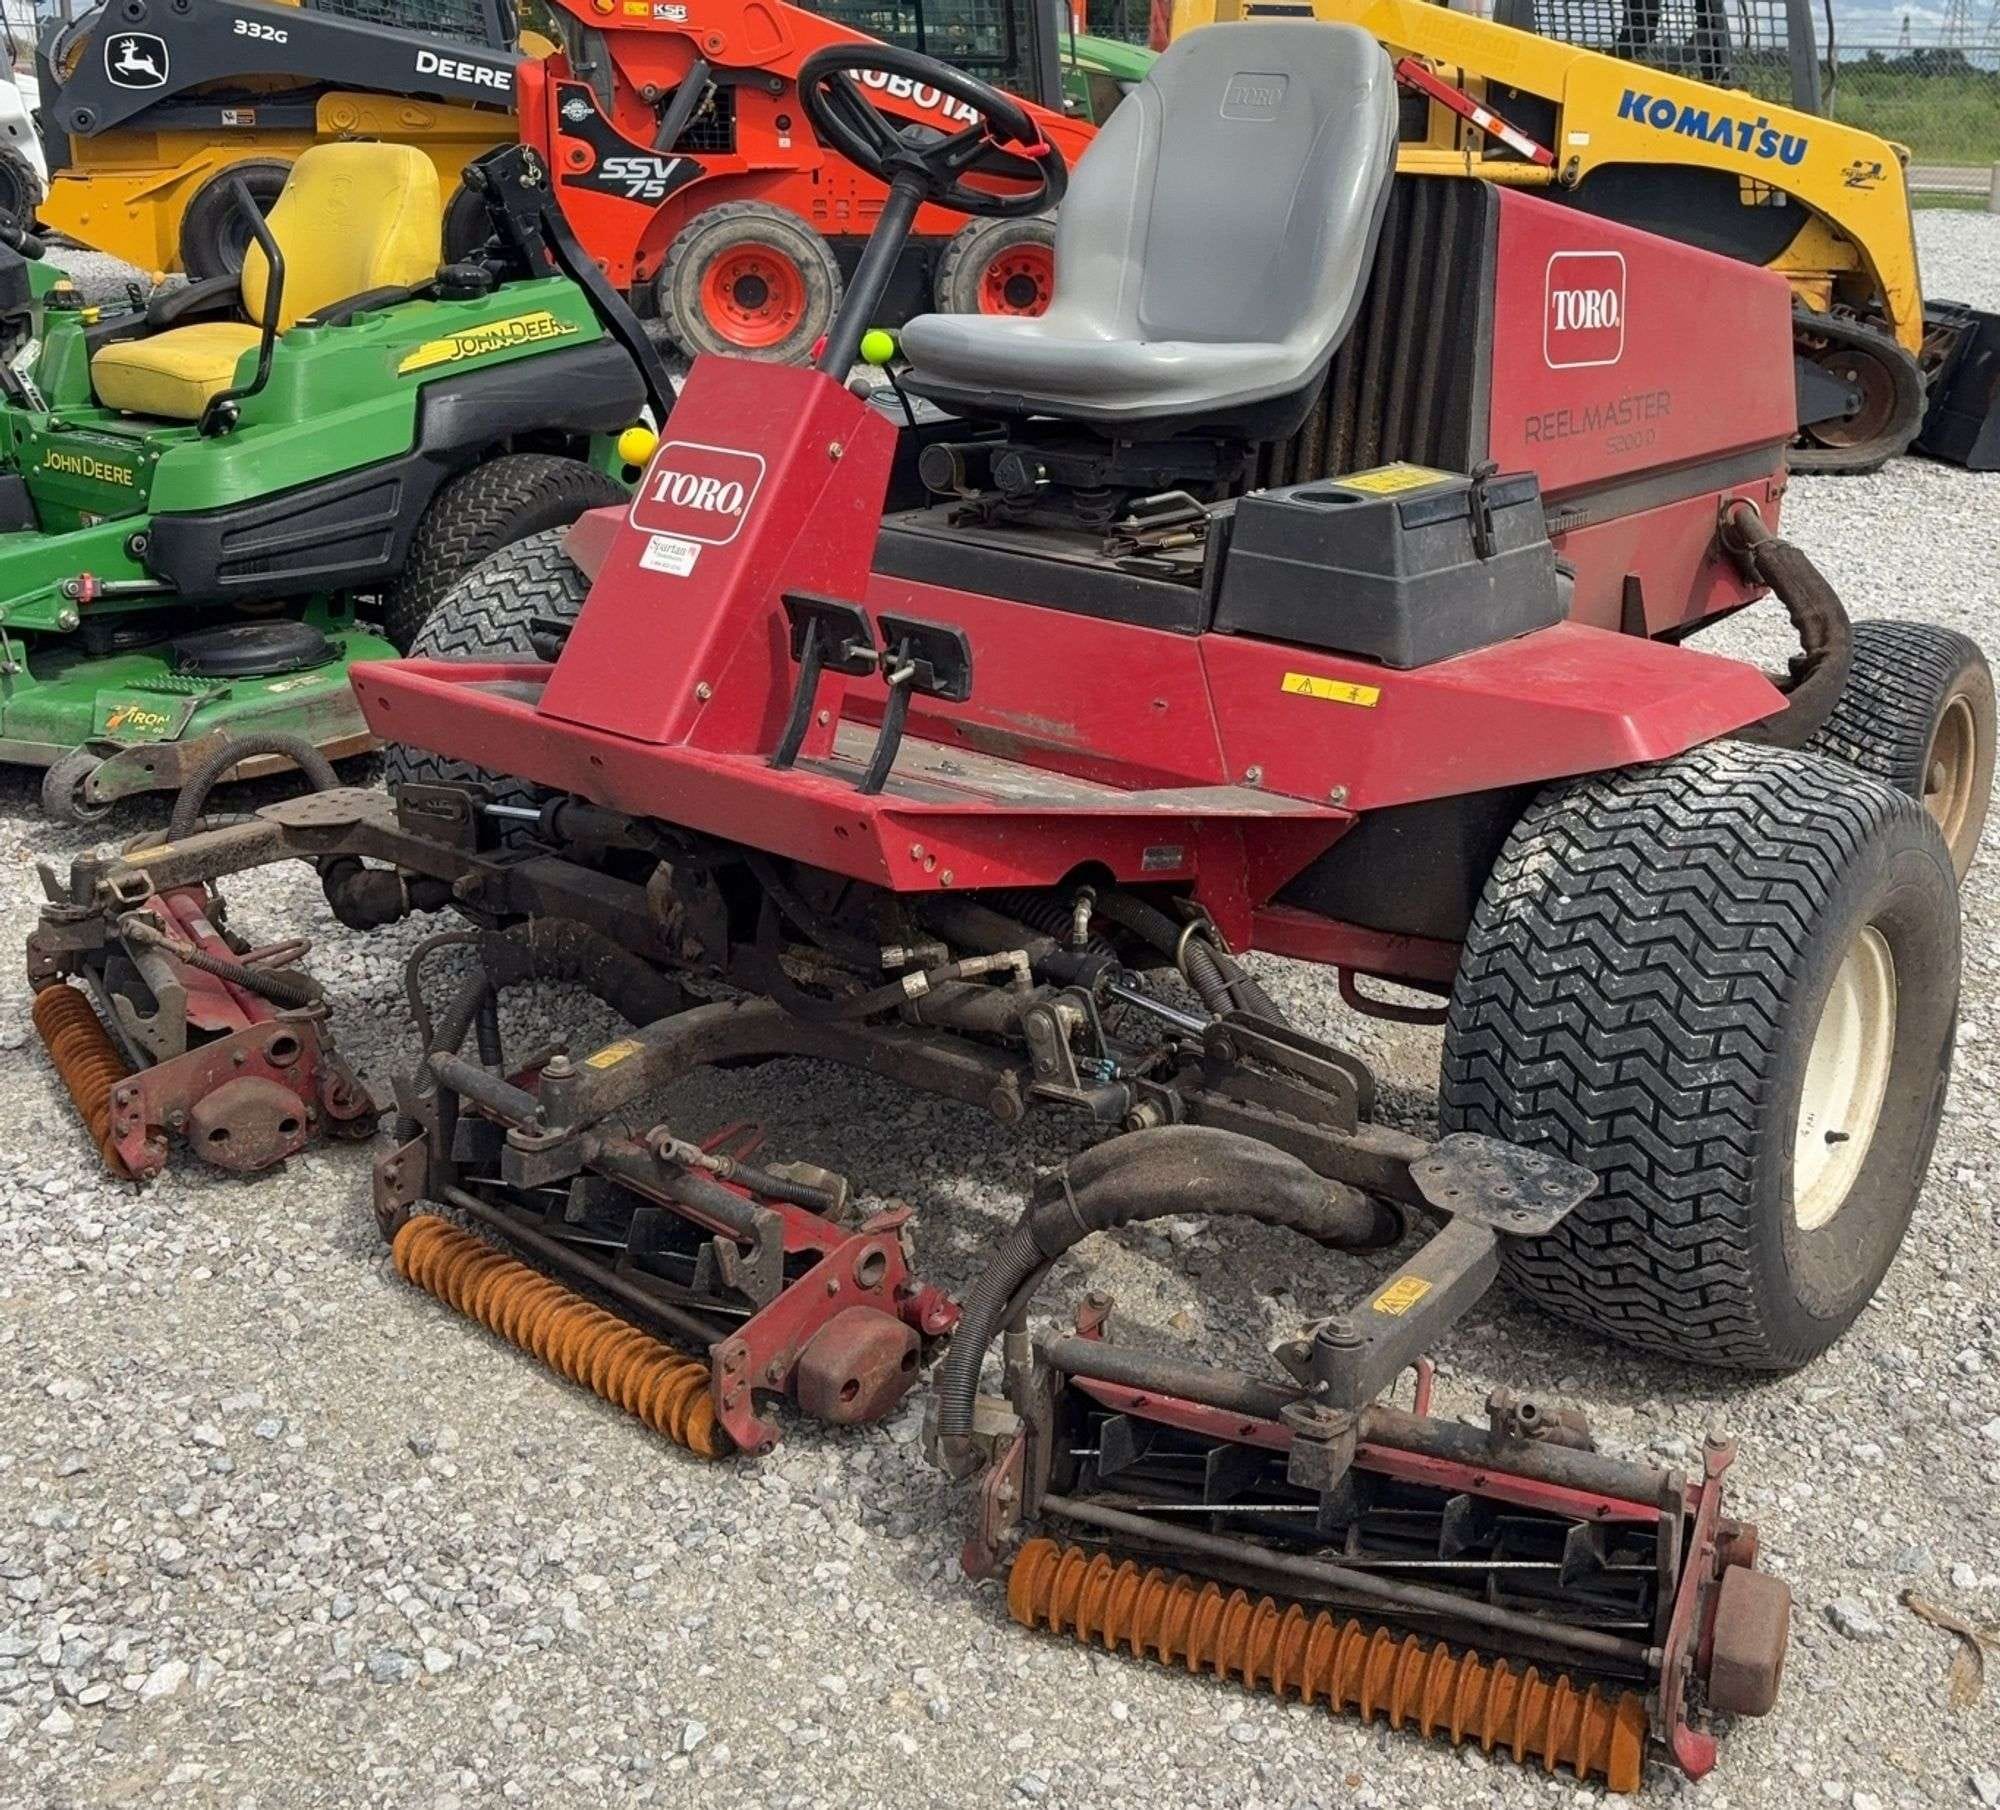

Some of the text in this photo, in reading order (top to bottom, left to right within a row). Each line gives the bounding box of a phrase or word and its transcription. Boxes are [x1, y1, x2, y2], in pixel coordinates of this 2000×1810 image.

[233, 19, 289, 44] 332G
[415, 49, 513, 91] DEERE
[816, 68, 979, 126] UBOTA
[1616, 88, 1809, 167] KOMATSU
[598, 156, 682, 179] SSV
[624, 179, 666, 198] 75
[1551, 288, 1618, 331] TORO
[451, 328, 507, 358] JOHN
[1523, 389, 1672, 445] REELMASTER
[43, 448, 134, 487] JOHN DEERE
[650, 469, 745, 515] TORO
